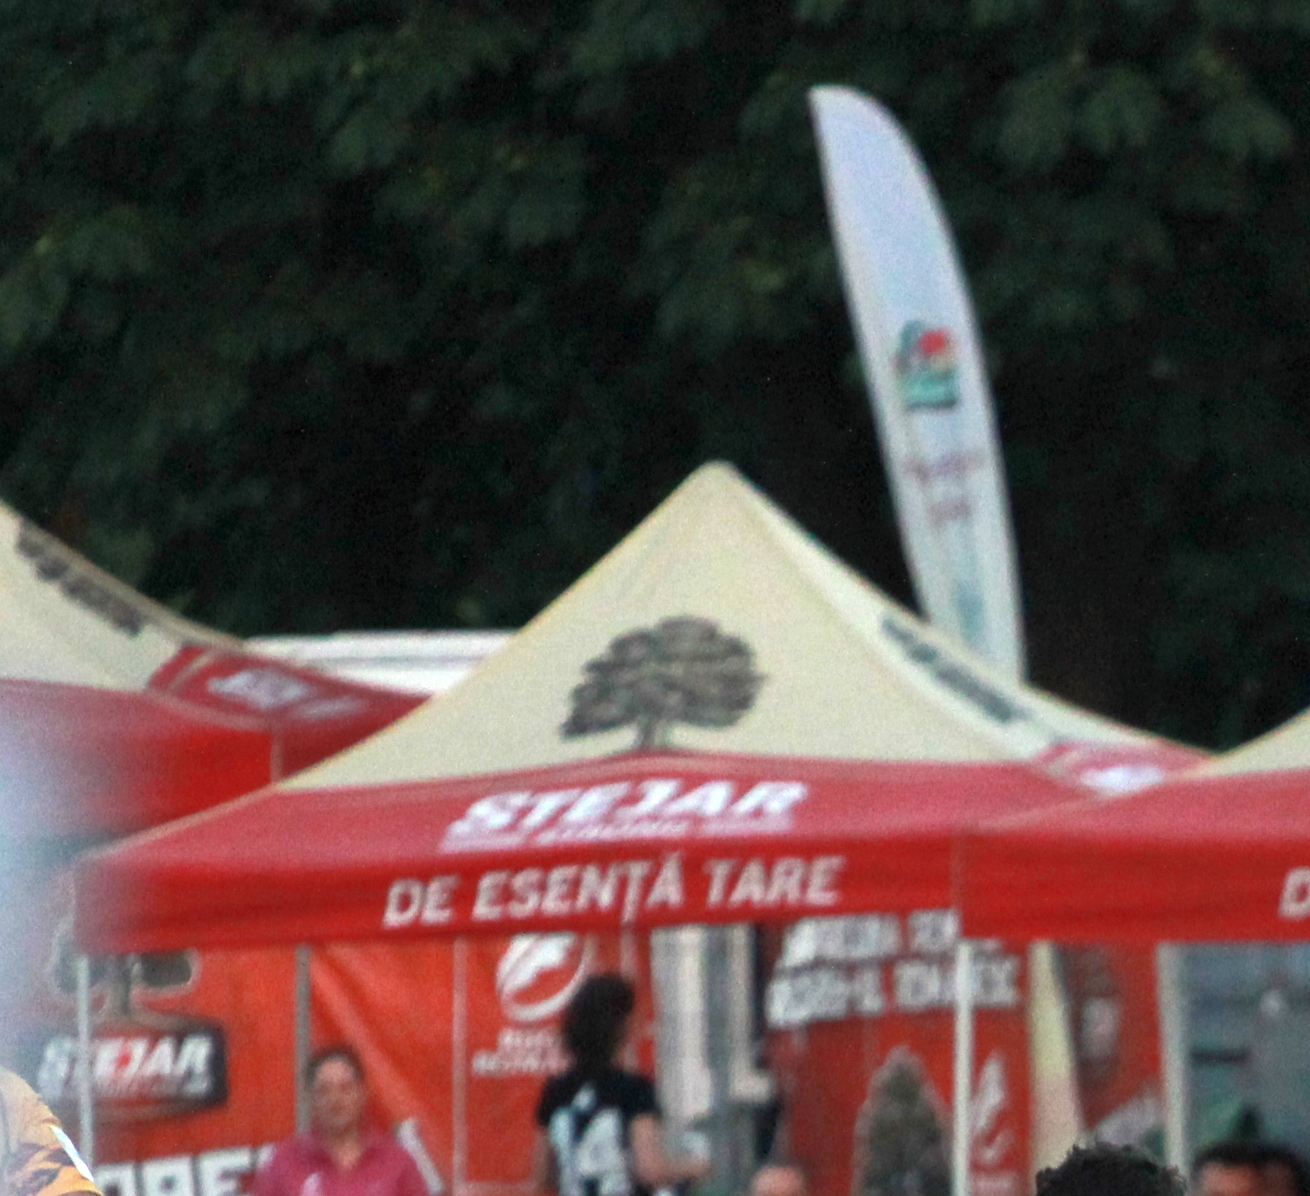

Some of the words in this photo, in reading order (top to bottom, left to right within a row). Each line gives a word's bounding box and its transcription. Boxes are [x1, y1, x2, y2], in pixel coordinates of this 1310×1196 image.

[441, 778, 808, 840] STEJAR
[383, 874, 459, 928] DE
[704, 854, 847, 910] TARE
